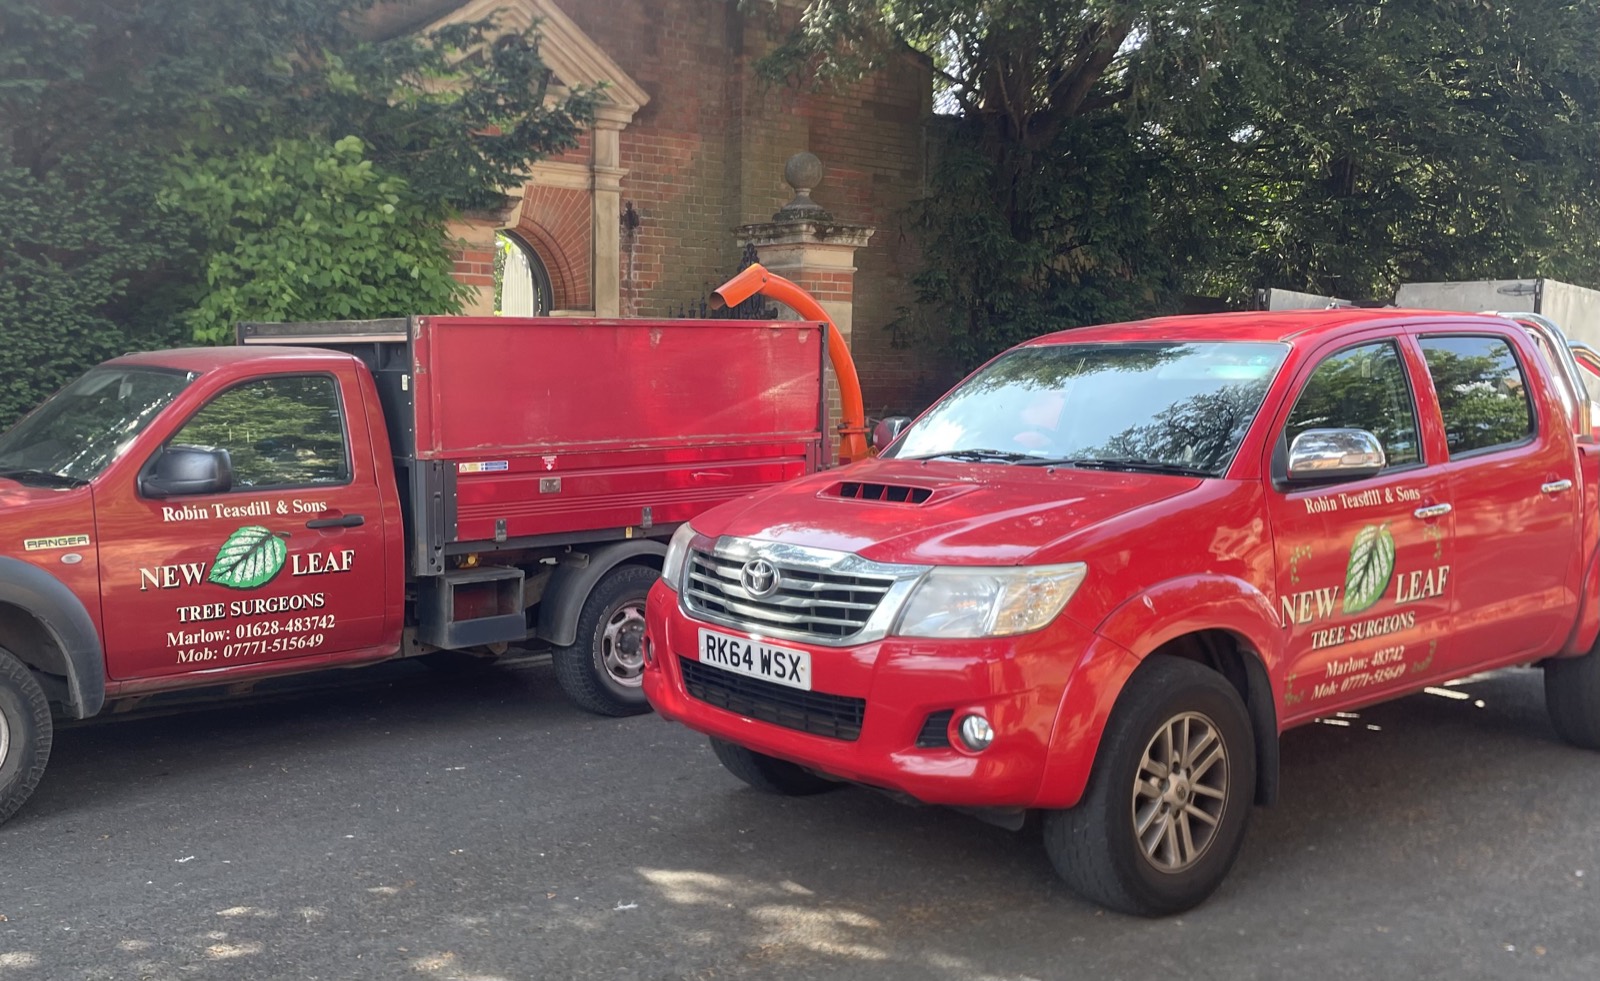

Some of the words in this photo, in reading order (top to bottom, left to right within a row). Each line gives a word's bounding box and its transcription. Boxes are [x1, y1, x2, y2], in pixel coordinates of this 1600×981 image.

[162, 506, 208, 522] Robin
[211, 500, 271, 520] Teasdill
[276, 500, 289, 515] &
[293, 499, 328, 514] Sons
[1304, 496, 1337, 514] Robin
[1339, 489, 1382, 509] Teasdill
[1385, 489, 1394, 503] &
[1397, 486, 1421, 501] Sons
[26, 536, 87, 548] RANGER
[139, 562, 207, 590] NEW
[291, 550, 355, 577] LEAF
[177, 606, 225, 622] TREE
[230, 593, 325, 617] SURGEONS
[1280, 586, 1340, 629] NEW
[1395, 565, 1450, 604] LEAF
[166, 629, 231, 648] Marlow:
[235, 614, 336, 639] 01628-483742
[1311, 626, 1346, 650] TREE
[1349, 611, 1416, 641] SURGEONS
[176, 648, 218, 664] Mob:
[223, 633, 324, 658] 07771-515649
[706, 634, 754, 671] RK64
[760, 647, 802, 683] WSX
[1325, 658, 1370, 679] Marlow:
